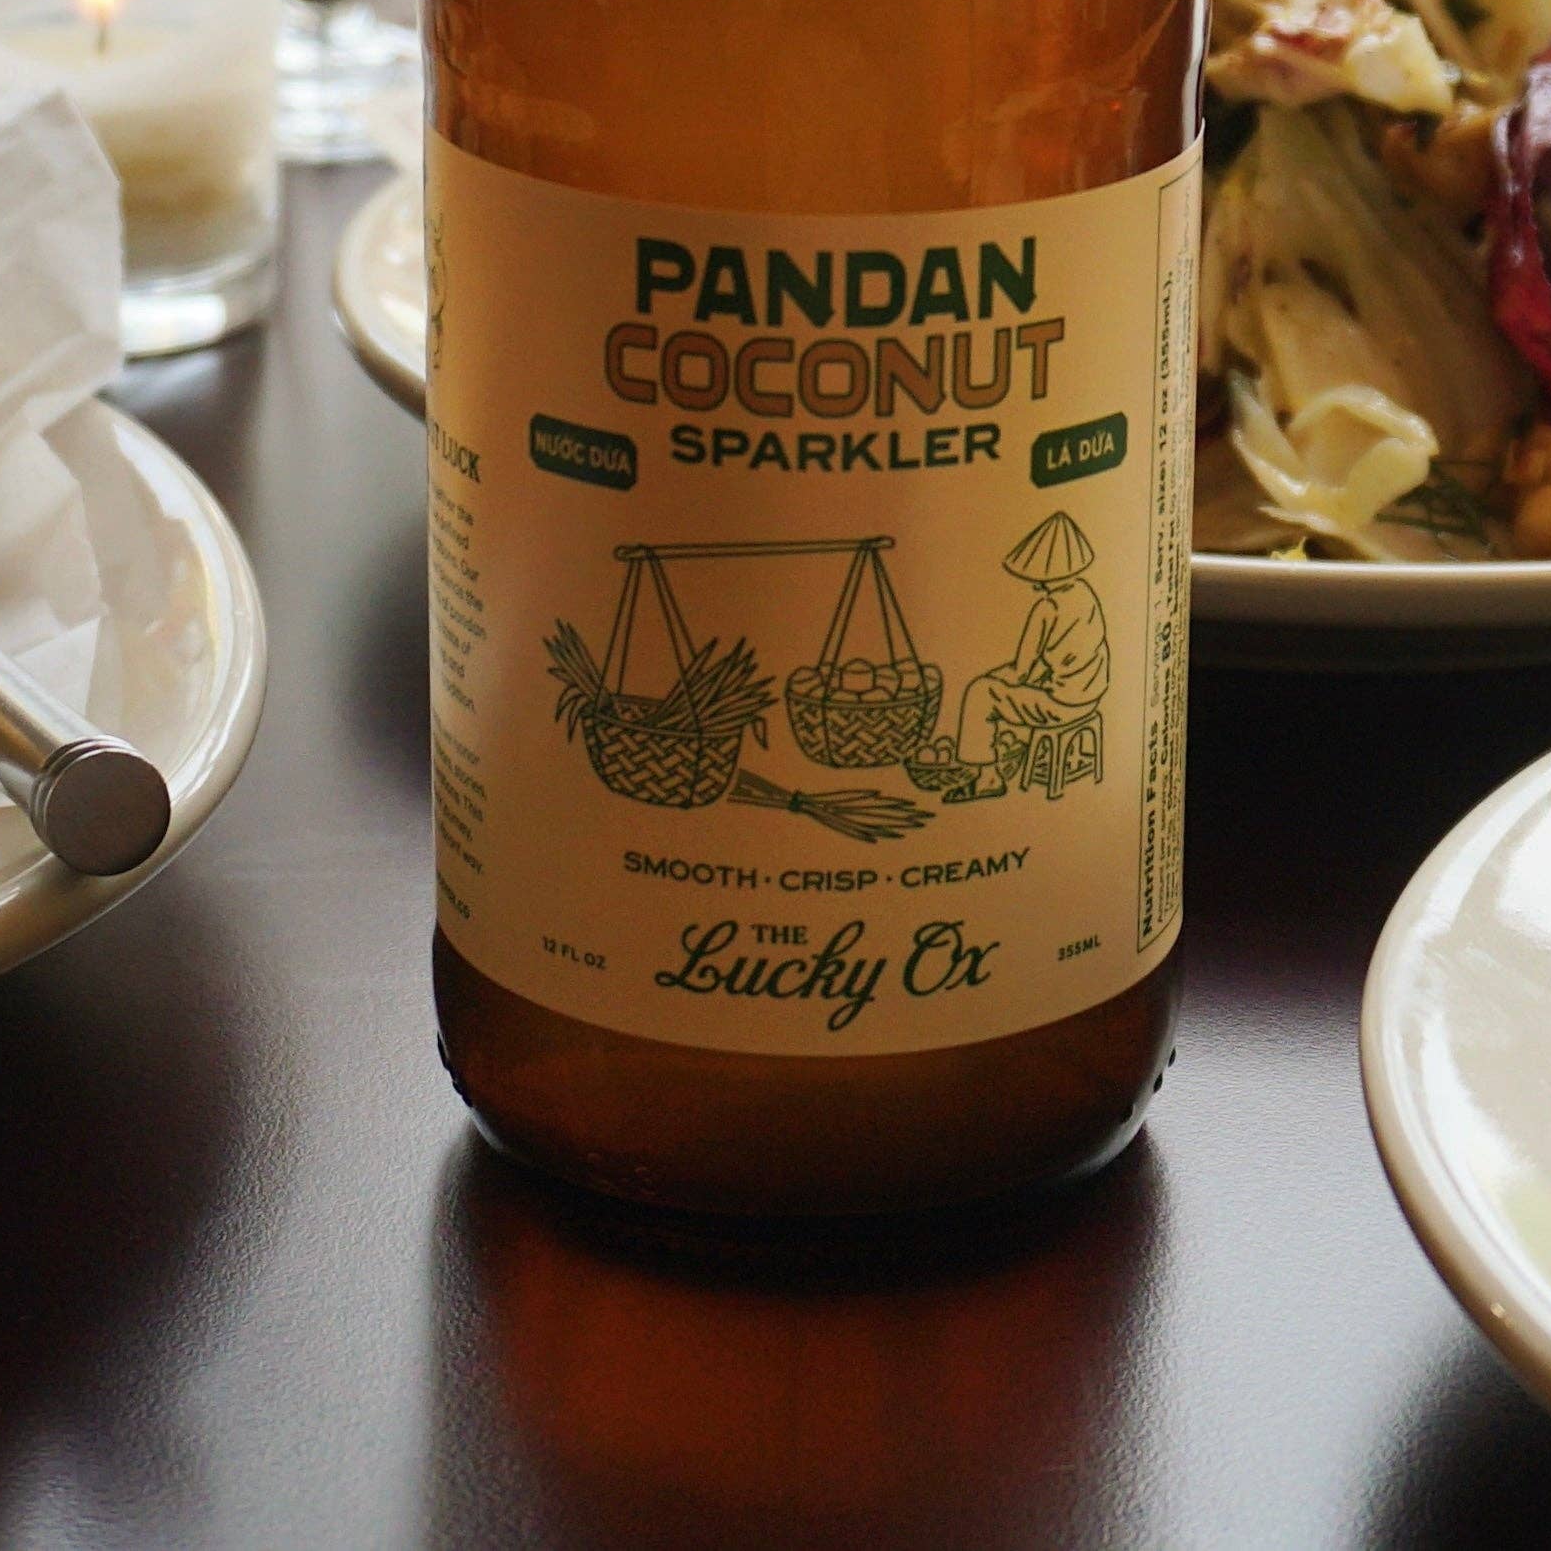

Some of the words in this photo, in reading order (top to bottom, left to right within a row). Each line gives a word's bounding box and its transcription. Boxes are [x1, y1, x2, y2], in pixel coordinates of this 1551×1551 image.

[635, 236, 1037, 328] PANDAN
[604, 316, 1065, 419] COCONUT
[1161, 388, 1168, 414] oz
[669, 422, 1001, 473] SPARKLER
[1159, 423, 1167, 452] 12
[1146, 719, 1158, 802] Facts
[622, 850, 758, 889] SMOOTH
[779, 869, 878, 892] CRISP
[900, 846, 1031, 888] CREAMY
[1143, 809, 1156, 937] Nutrition
[750, 922, 809, 946] THE
[1058, 933, 1102, 962] 355ML
[654, 919, 888, 1033] Lucky
[902, 919, 1001, 997] Ox
